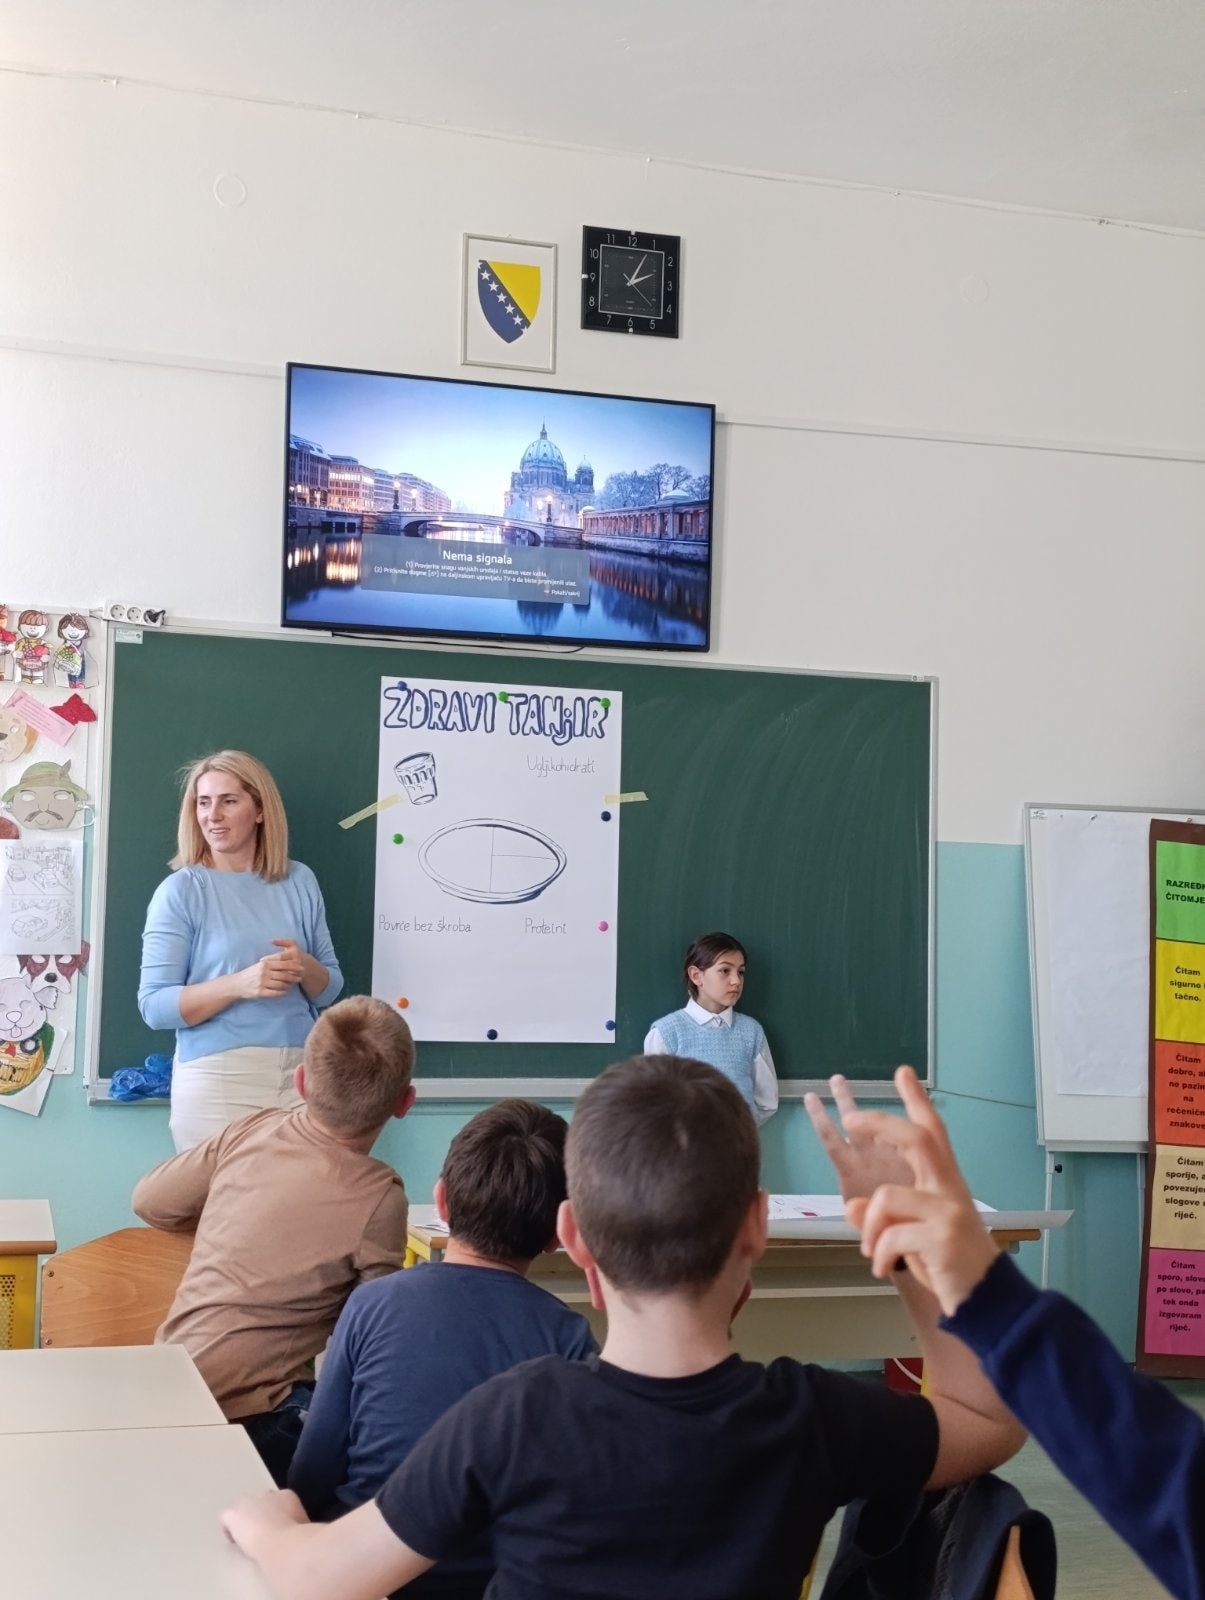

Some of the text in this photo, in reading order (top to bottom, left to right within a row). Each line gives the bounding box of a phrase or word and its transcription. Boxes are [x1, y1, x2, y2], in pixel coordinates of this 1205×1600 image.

[607, 233, 615, 244] 11
[628, 236, 637, 247] 12
[590, 248, 599, 259] 10
[442, 550, 513, 566] Nema signala
[374, 565, 382, 574] (2)
[409, 569, 427, 577] dugme
[448, 571, 475, 579] daljinskom
[405, 560, 413, 569] (1)
[414, 561, 440, 571] Provjerite
[457, 565, 479, 573] vanjskih
[383, 687, 497, 734] ZDRAVI
[1165, 891, 1205, 904] ČITOMJE
[414, 915, 433, 932] bez
[436, 915, 472, 933] škroba
[525, 917, 567, 935] Proteini
[1175, 965, 1201, 976] Čitam
[1169, 979, 1201, 989] sigurno
[1174, 992, 1202, 1002] tačno.
[1175, 1053, 1201, 1064] Čitam
[1168, 1067, 1196, 1077] dobro,
[1168, 1080, 1179, 1088] ne
[1183, 1095, 1194, 1103] na
[1169, 1120, 1205, 1130] znakove
[1177, 1156, 1204, 1167] Čitam
[1165, 1171, 1199, 1181] sporije,
[1165, 1197, 1200, 1207] slogove
[1171, 1260, 1196, 1270] Čitam
[1157, 1274, 1183, 1282] sporo,
[1156, 1286, 1167, 1294] po
[1169, 1286, 1194, 1295] slovo,
[1163, 1298, 1199, 1307] tek onda
[1159, 1309, 1202, 1320] izgovaram
